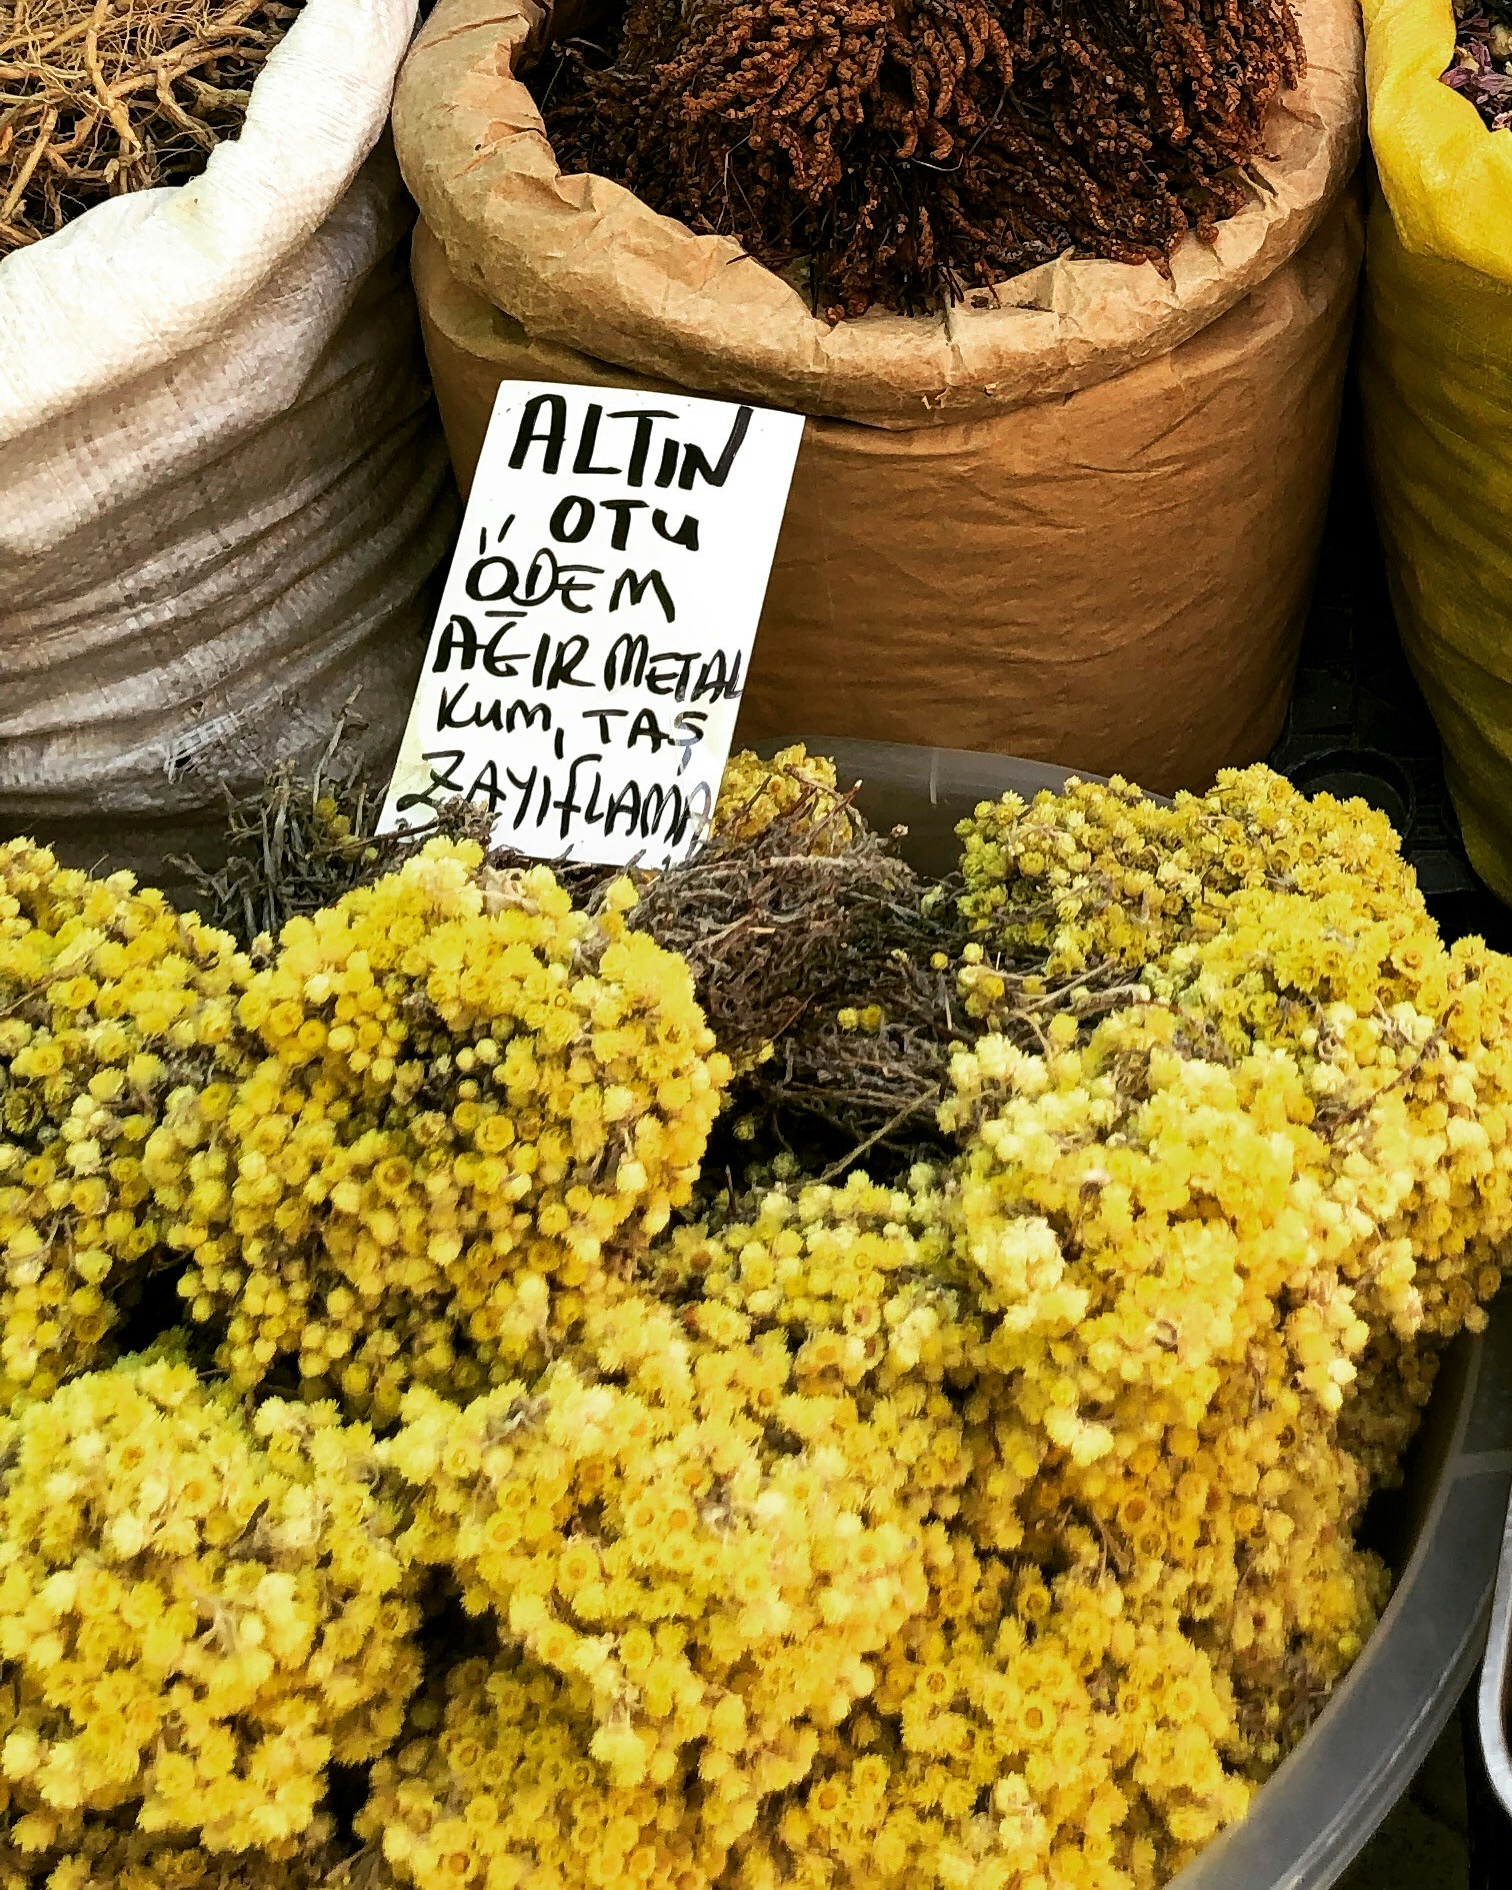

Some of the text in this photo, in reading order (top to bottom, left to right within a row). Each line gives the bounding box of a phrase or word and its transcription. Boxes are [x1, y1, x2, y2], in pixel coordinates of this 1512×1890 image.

[508, 393, 754, 490] ALTIN
[464, 514, 677, 624] ÖDEM
[549, 495, 700, 552] OTU
[431, 610, 746, 705] AĞIR METAL
[582, 709, 709, 776] TAŞ
